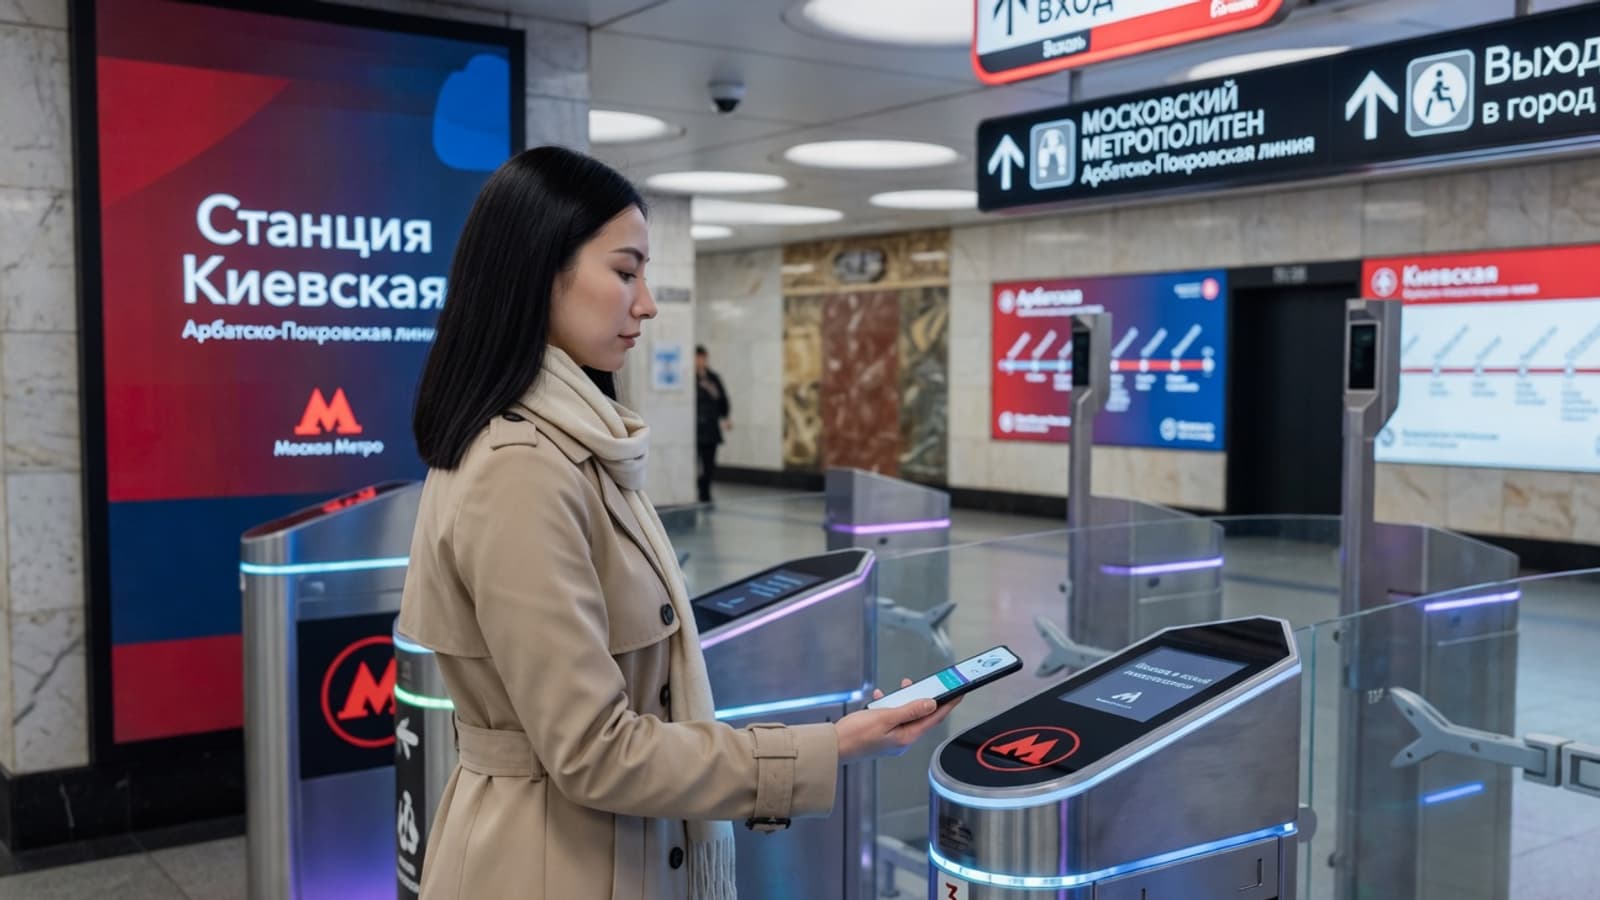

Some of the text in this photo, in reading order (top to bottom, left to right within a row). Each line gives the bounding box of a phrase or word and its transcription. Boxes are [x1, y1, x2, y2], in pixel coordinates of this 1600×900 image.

[1484, 36, 1600, 86] Выход
[1081, 80, 1239, 134] МОСКОВСКИЙ
[1482, 86, 1596, 124] в город
[1081, 109, 1265, 162] МЕТРОПОЛИТЕН
[1257, 136, 1315, 160] линия
[196, 193, 432, 258] Станция
[182, 253, 448, 309] Киевская
[182, 318, 437, 345] Арбатско-Покровская лини
